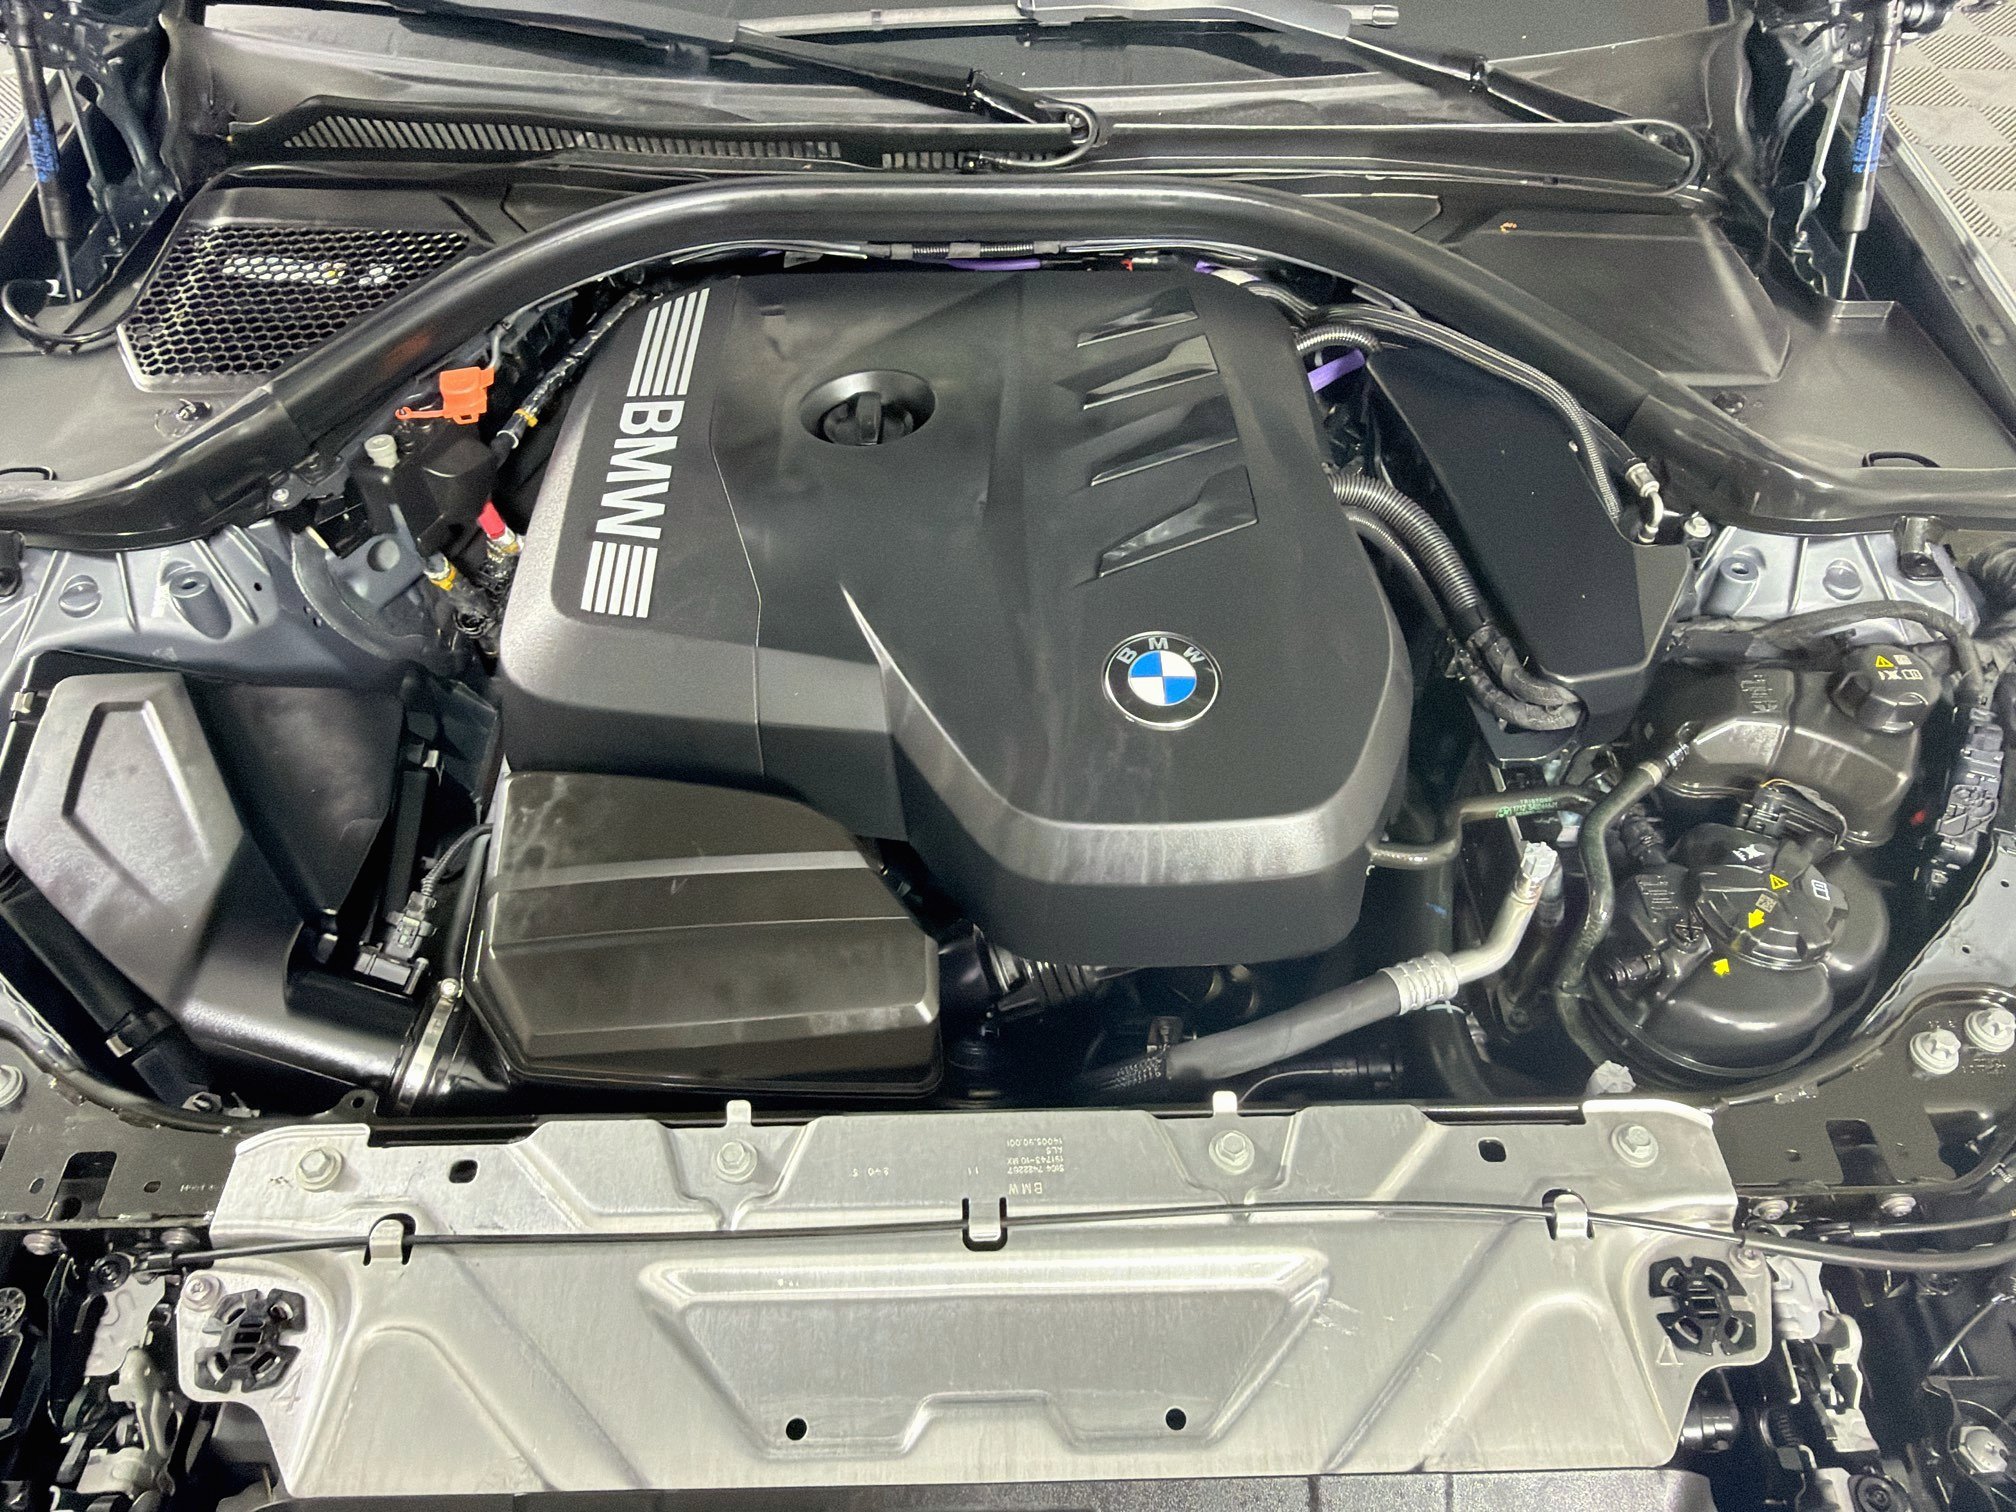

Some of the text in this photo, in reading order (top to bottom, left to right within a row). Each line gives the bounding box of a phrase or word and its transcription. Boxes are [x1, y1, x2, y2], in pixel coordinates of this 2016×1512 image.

[595, 400, 685, 540] BMW
[1116, 637, 1206, 665] BMW
[1009, 1181, 1043, 1195] BMW
